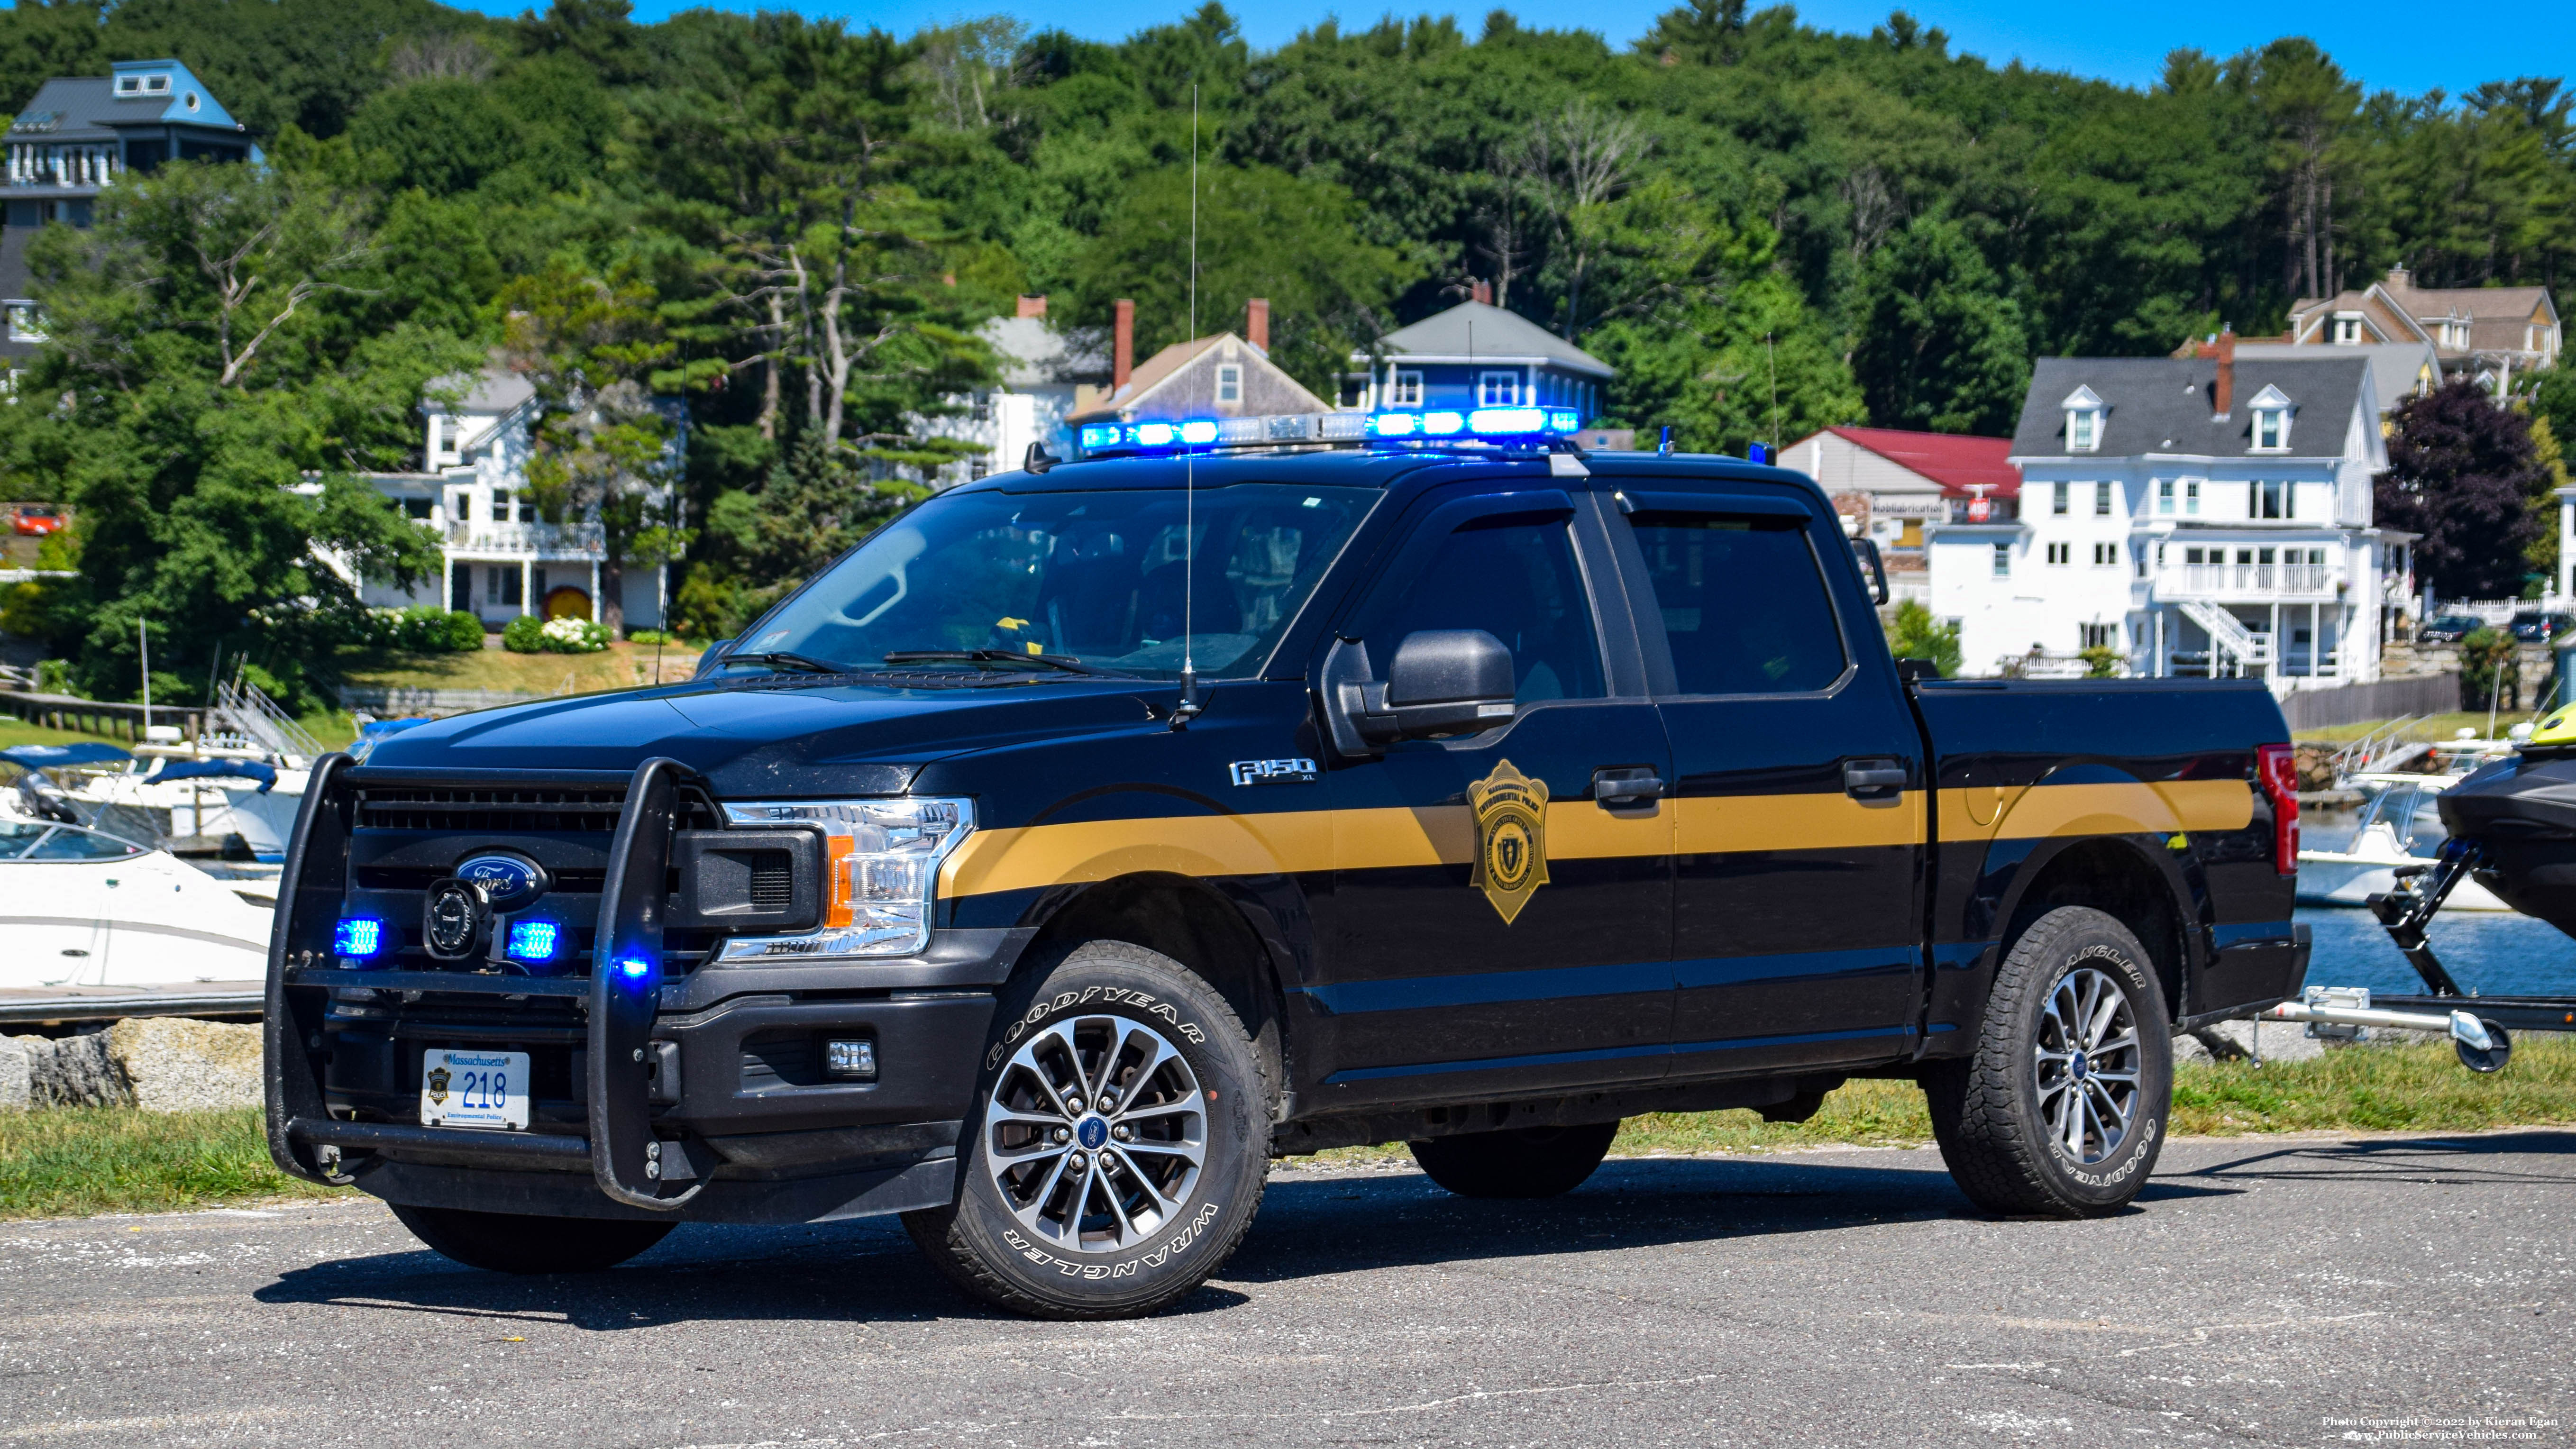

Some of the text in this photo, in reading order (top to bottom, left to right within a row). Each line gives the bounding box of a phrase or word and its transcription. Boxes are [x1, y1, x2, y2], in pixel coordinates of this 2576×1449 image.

[1479, 792, 1539, 815] ENVIRONMENTAL POLICE
[472, 866, 514, 891] Ford
[448, 1054, 505, 1066] Massachusetts
[463, 1072, 506, 1109] 218
[1089, 1125, 1097, 1142] Ford
[1004, 1203, 1218, 1279] WRANGLER
